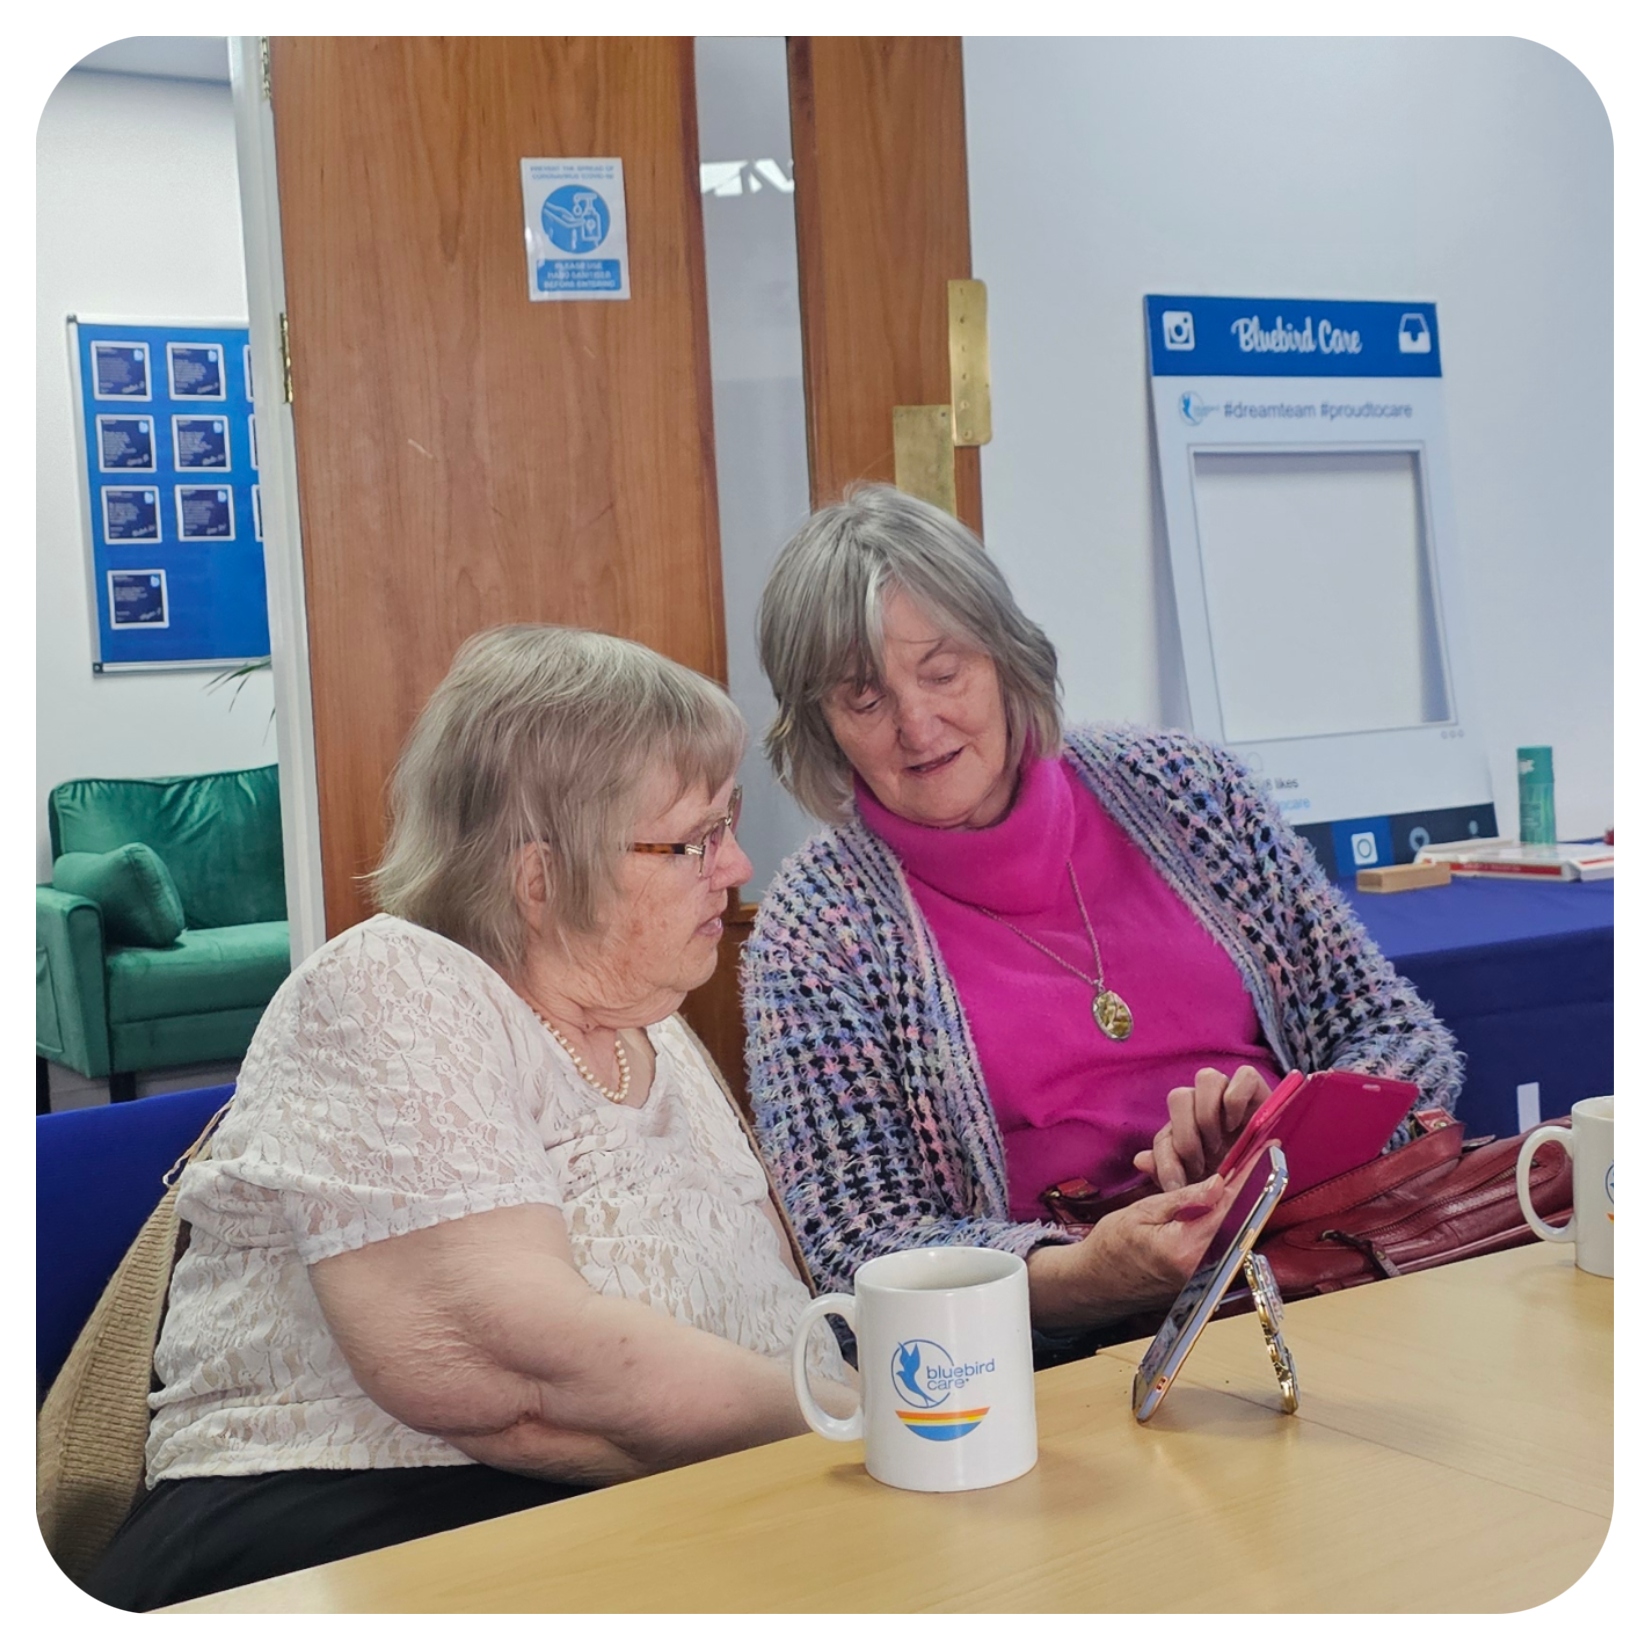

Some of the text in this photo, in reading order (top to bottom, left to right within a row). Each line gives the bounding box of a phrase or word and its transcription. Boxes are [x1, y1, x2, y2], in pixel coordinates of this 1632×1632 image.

[1231, 315, 1363, 355] Bluebird Care
[1224, 403, 1317, 420] #dreamteam
[1320, 402, 1413, 422] #proudtocare
[926, 1358, 995, 1380] bluebird
[926, 1378, 965, 1391] care
